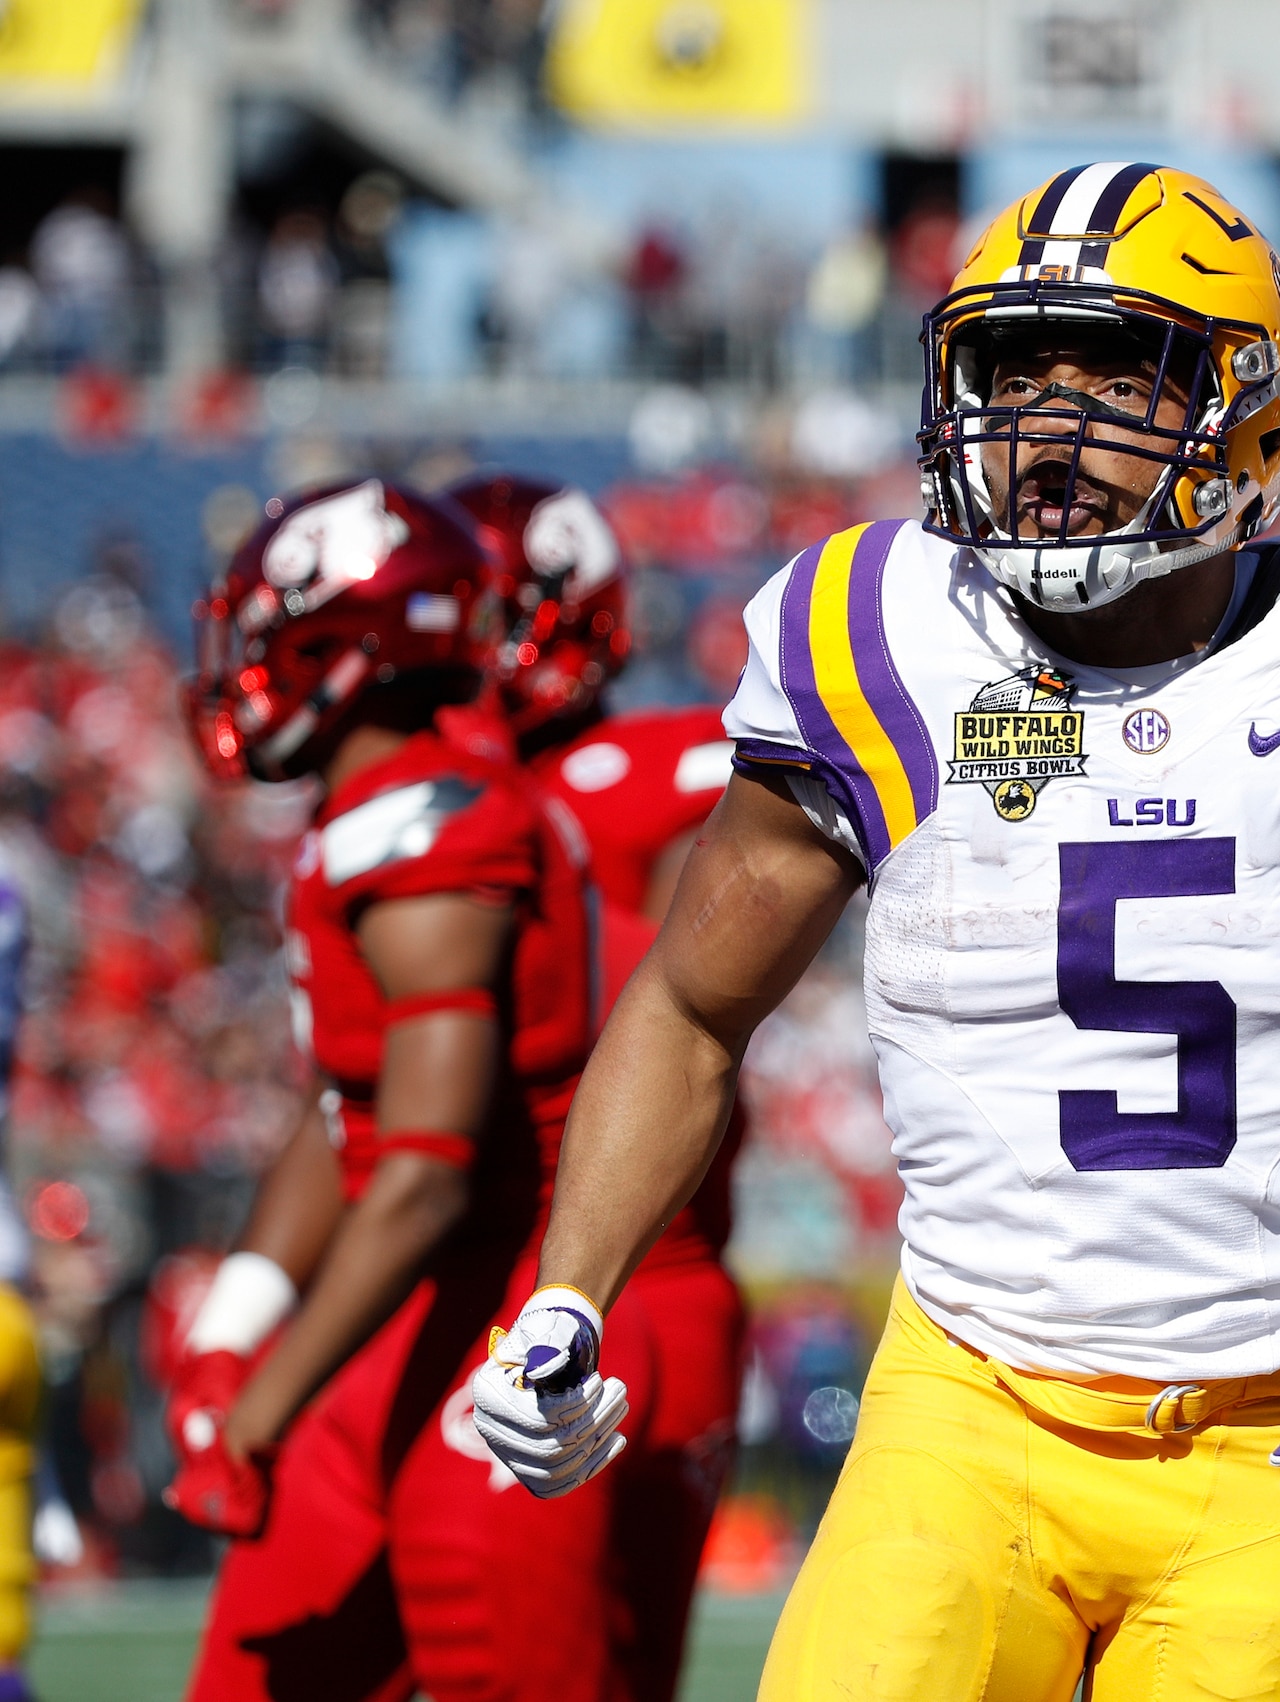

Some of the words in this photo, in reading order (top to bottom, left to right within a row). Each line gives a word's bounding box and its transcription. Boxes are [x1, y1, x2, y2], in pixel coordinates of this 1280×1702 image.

[1030, 568, 1078, 579] Riddell
[961, 714, 1077, 739] BUFFALO
[1124, 709, 1170, 753] SEC
[962, 740, 1008, 758] WILD
[1015, 737, 1076, 756] WINGS
[958, 761, 1021, 780] CITRUS
[1026, 758, 1076, 776] BOWL
[1107, 798, 1197, 827] LSU
[1057, 836, 1238, 1172] 5
